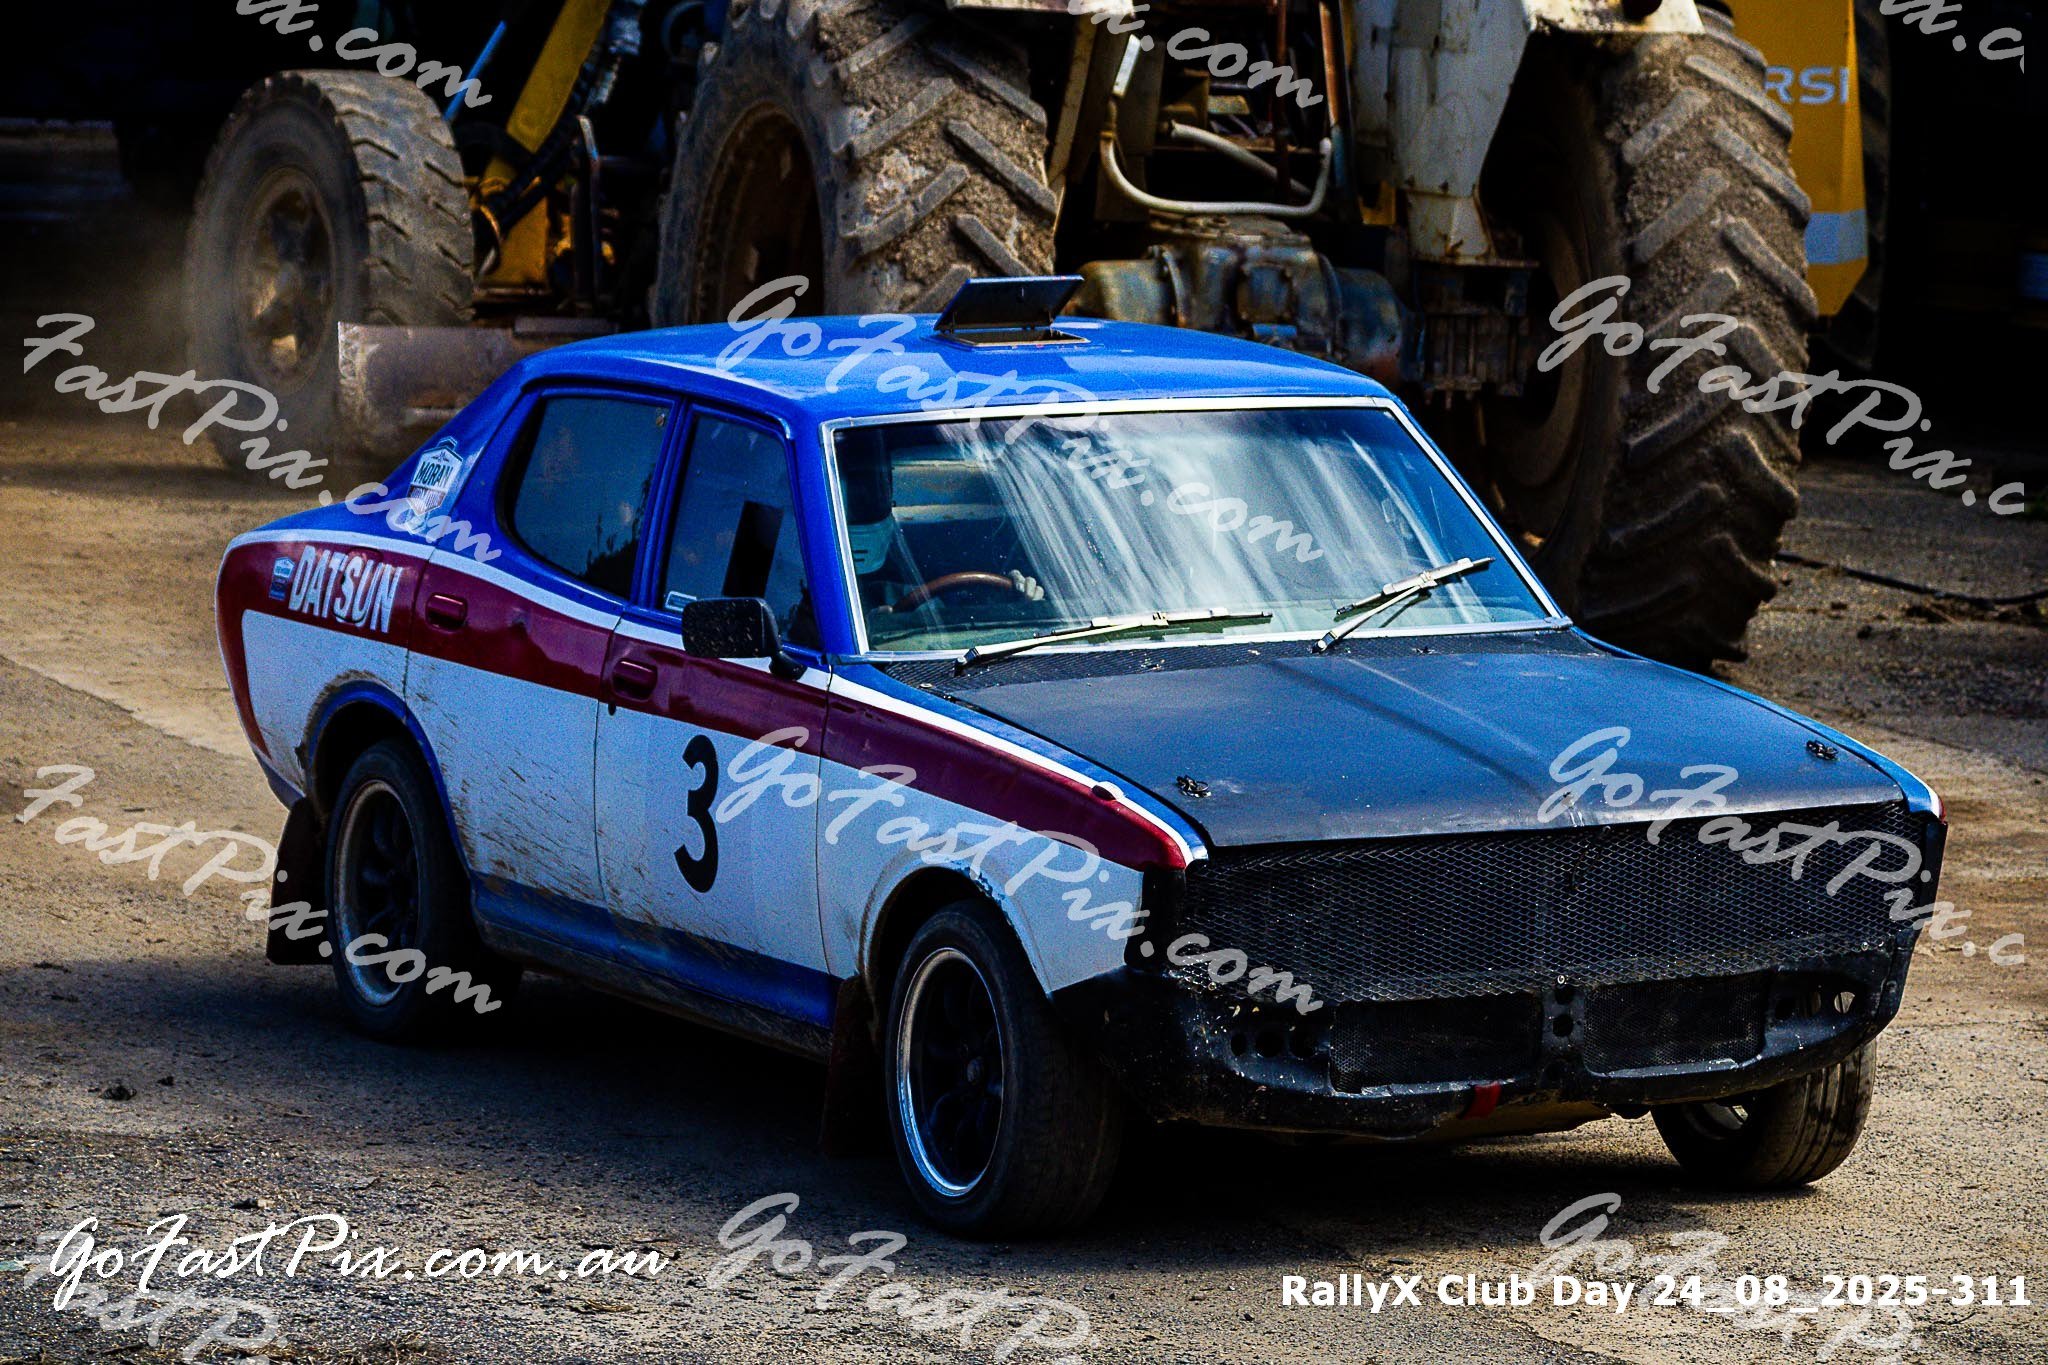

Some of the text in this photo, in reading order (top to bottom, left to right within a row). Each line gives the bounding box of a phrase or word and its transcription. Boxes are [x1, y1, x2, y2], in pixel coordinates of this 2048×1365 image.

[413, 461, 454, 489] MORAN
[288, 545, 403, 633] DATSUN
[673, 734, 720, 893] 3
